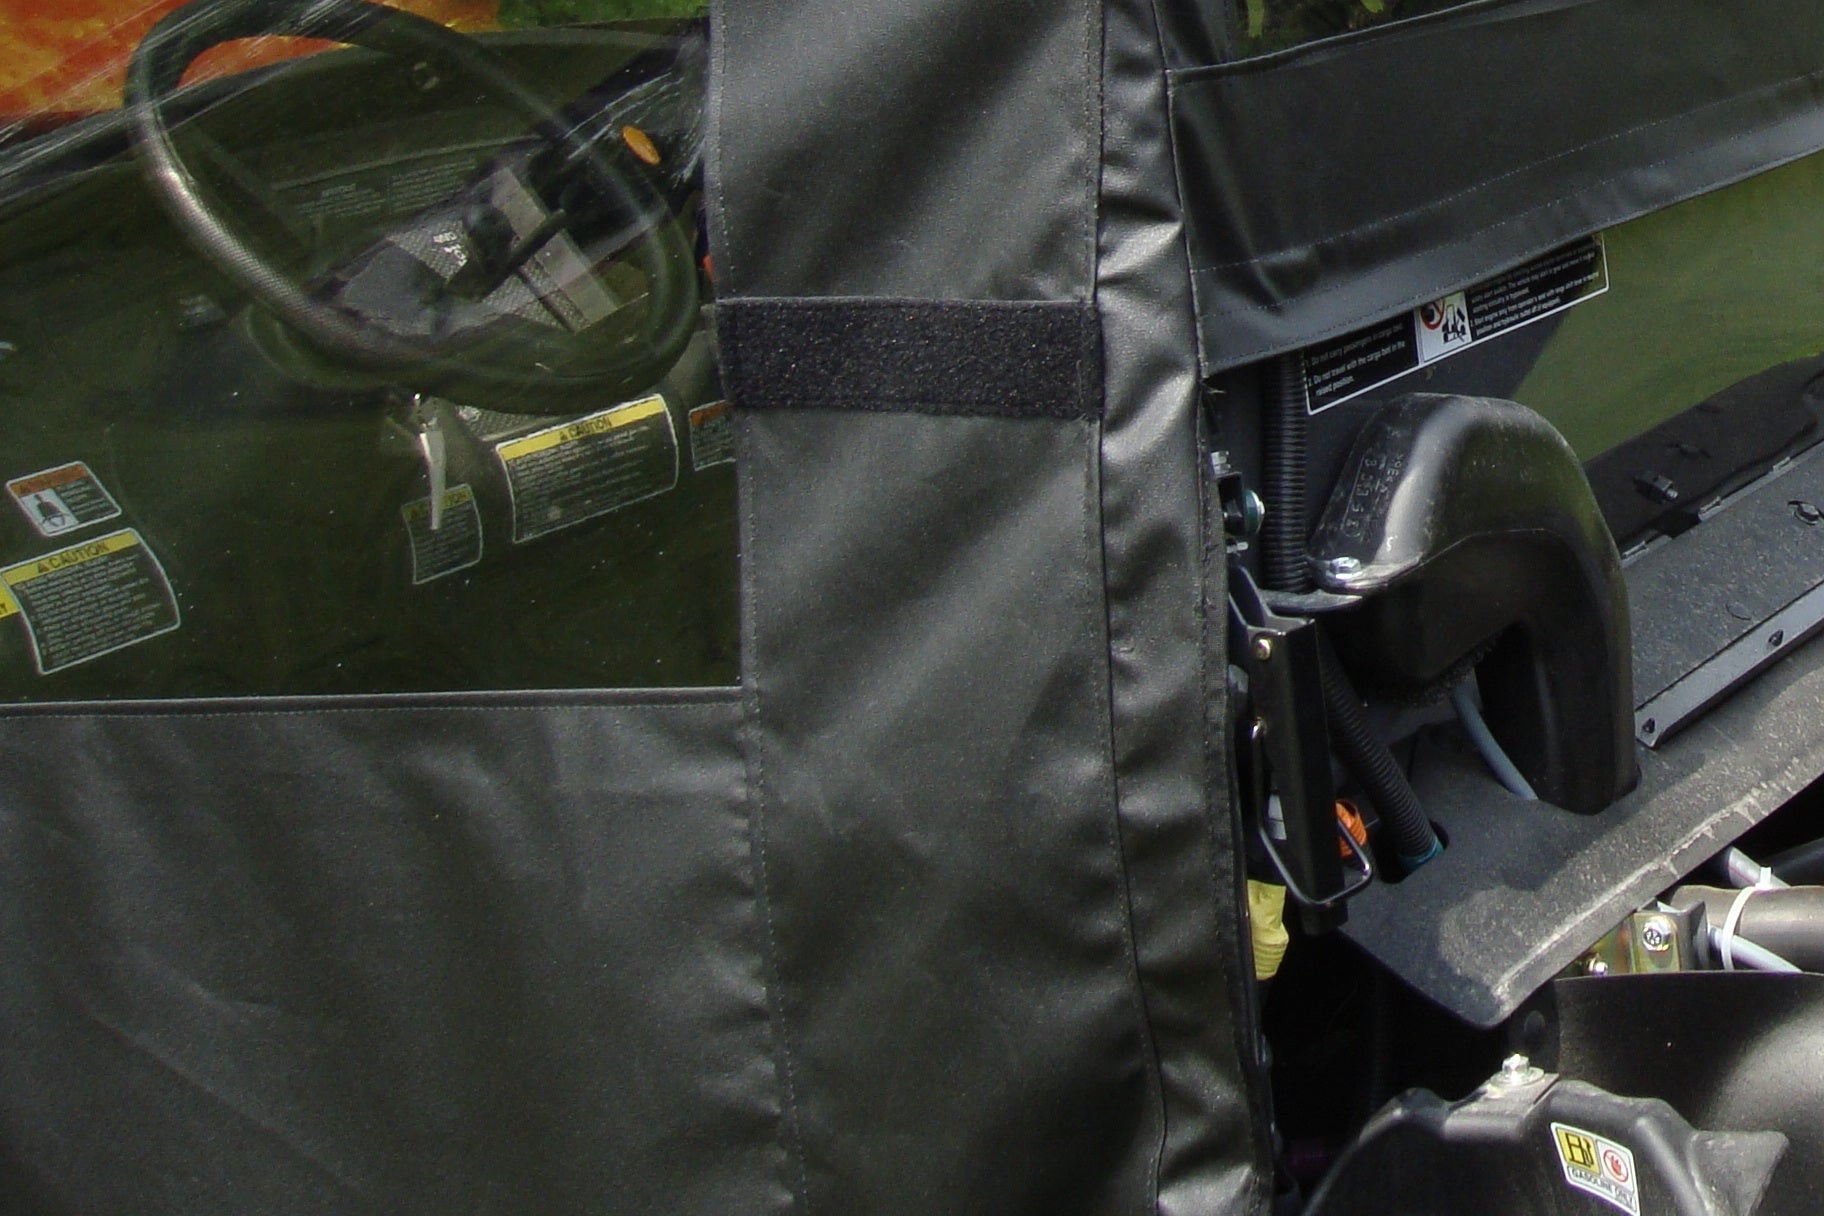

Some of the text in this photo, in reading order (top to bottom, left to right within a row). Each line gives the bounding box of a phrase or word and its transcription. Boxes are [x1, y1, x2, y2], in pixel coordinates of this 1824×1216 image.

[568, 416, 612, 438] CAUTION
[49, 542, 109, 568] CAUTION
[1571, 1166, 1613, 1195] GASOLINE
